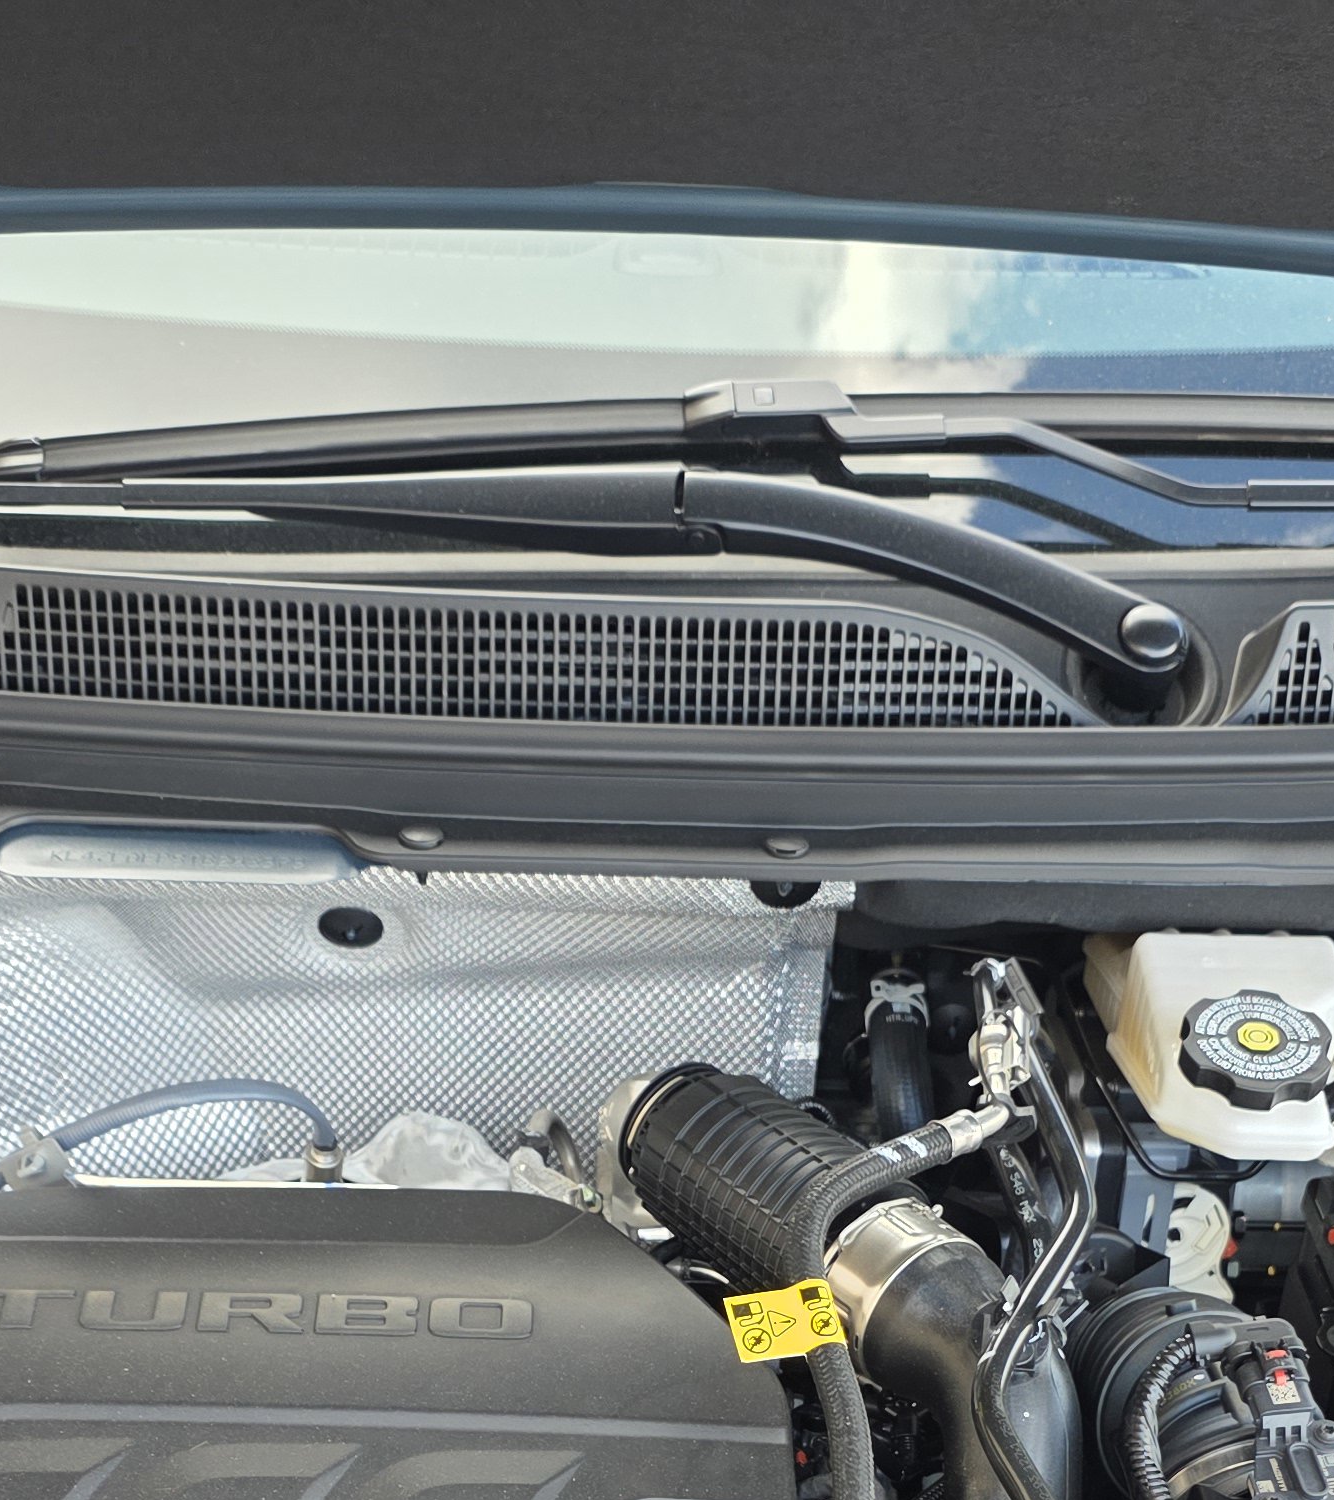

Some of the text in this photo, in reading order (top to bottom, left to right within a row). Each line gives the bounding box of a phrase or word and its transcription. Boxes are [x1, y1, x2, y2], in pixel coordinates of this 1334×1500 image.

[1209, 1053, 1233, 1070] FLUID
[1231, 1065, 1256, 1078] FROM
[1256, 1071, 1263, 1079] A
[1252, 1054, 1280, 1064] CLEAN
